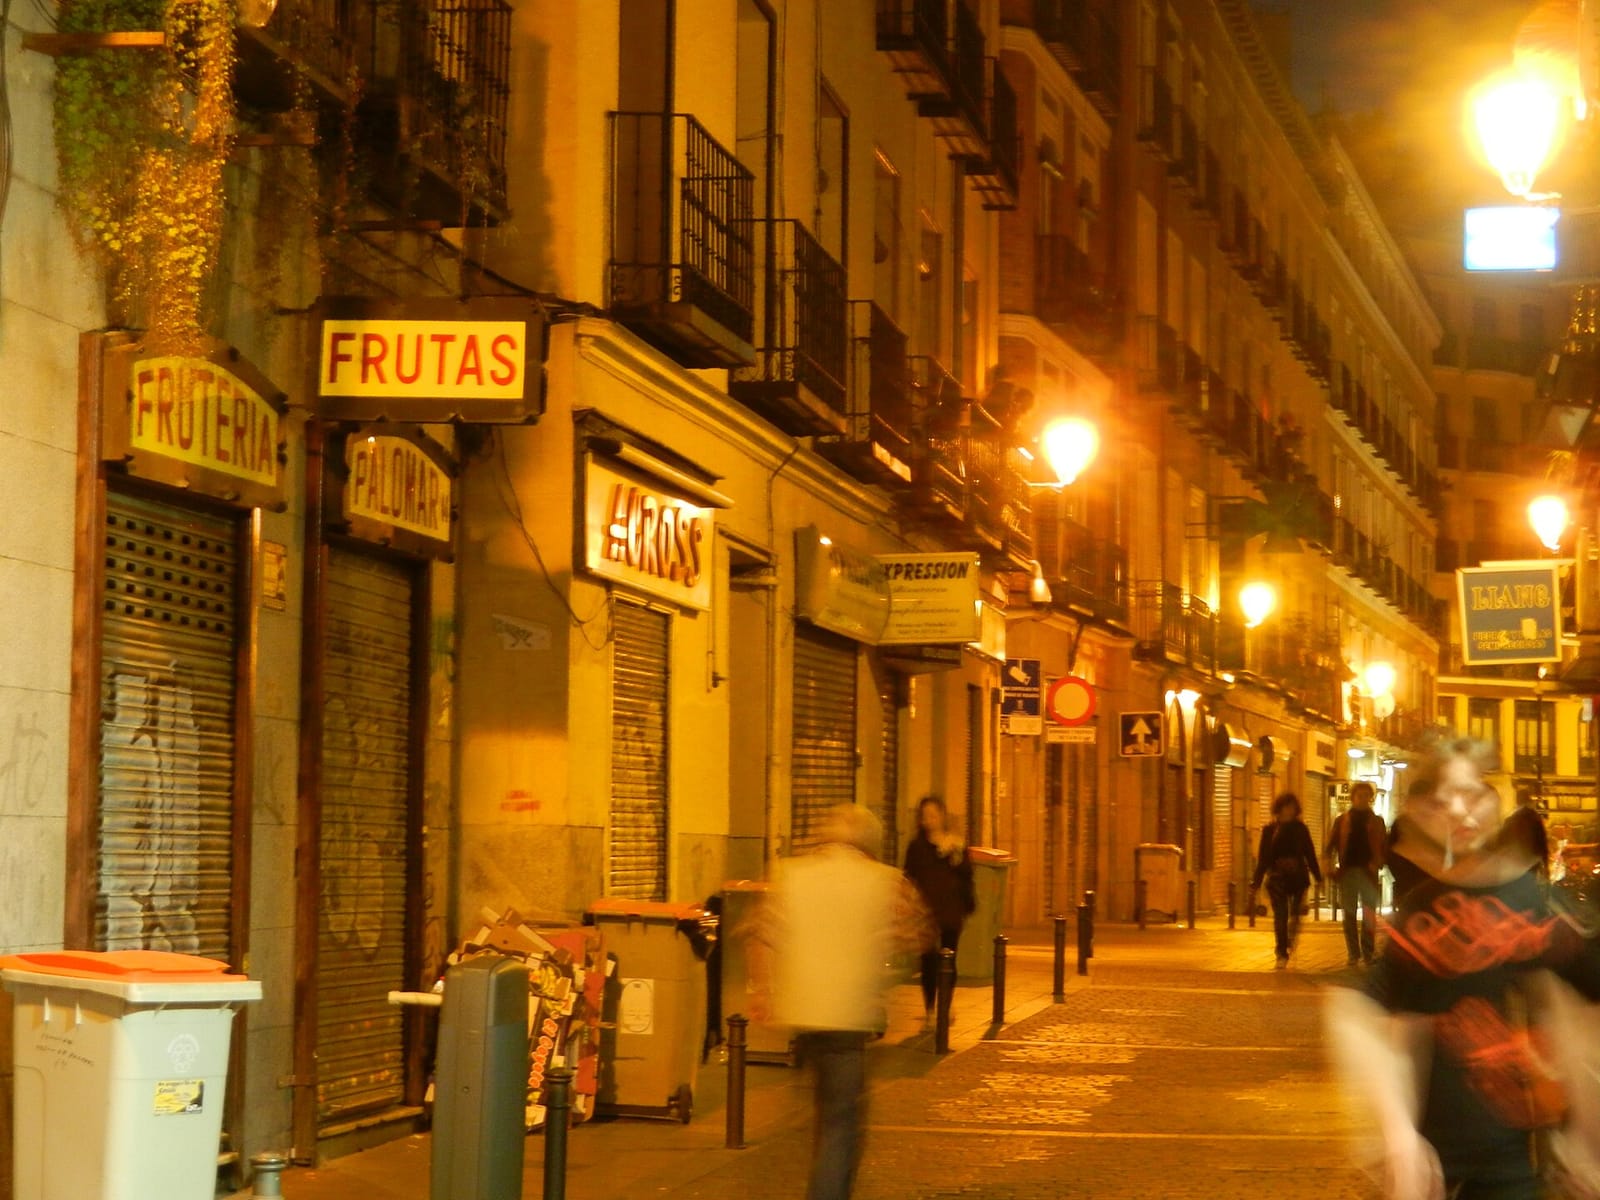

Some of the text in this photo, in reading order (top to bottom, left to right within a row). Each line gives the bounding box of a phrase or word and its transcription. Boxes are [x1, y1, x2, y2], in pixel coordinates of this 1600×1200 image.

[329, 333, 517, 386] FRUTAS
[137, 366, 272, 467] FRUTERIA
[354, 446, 440, 530] PALOMAR
